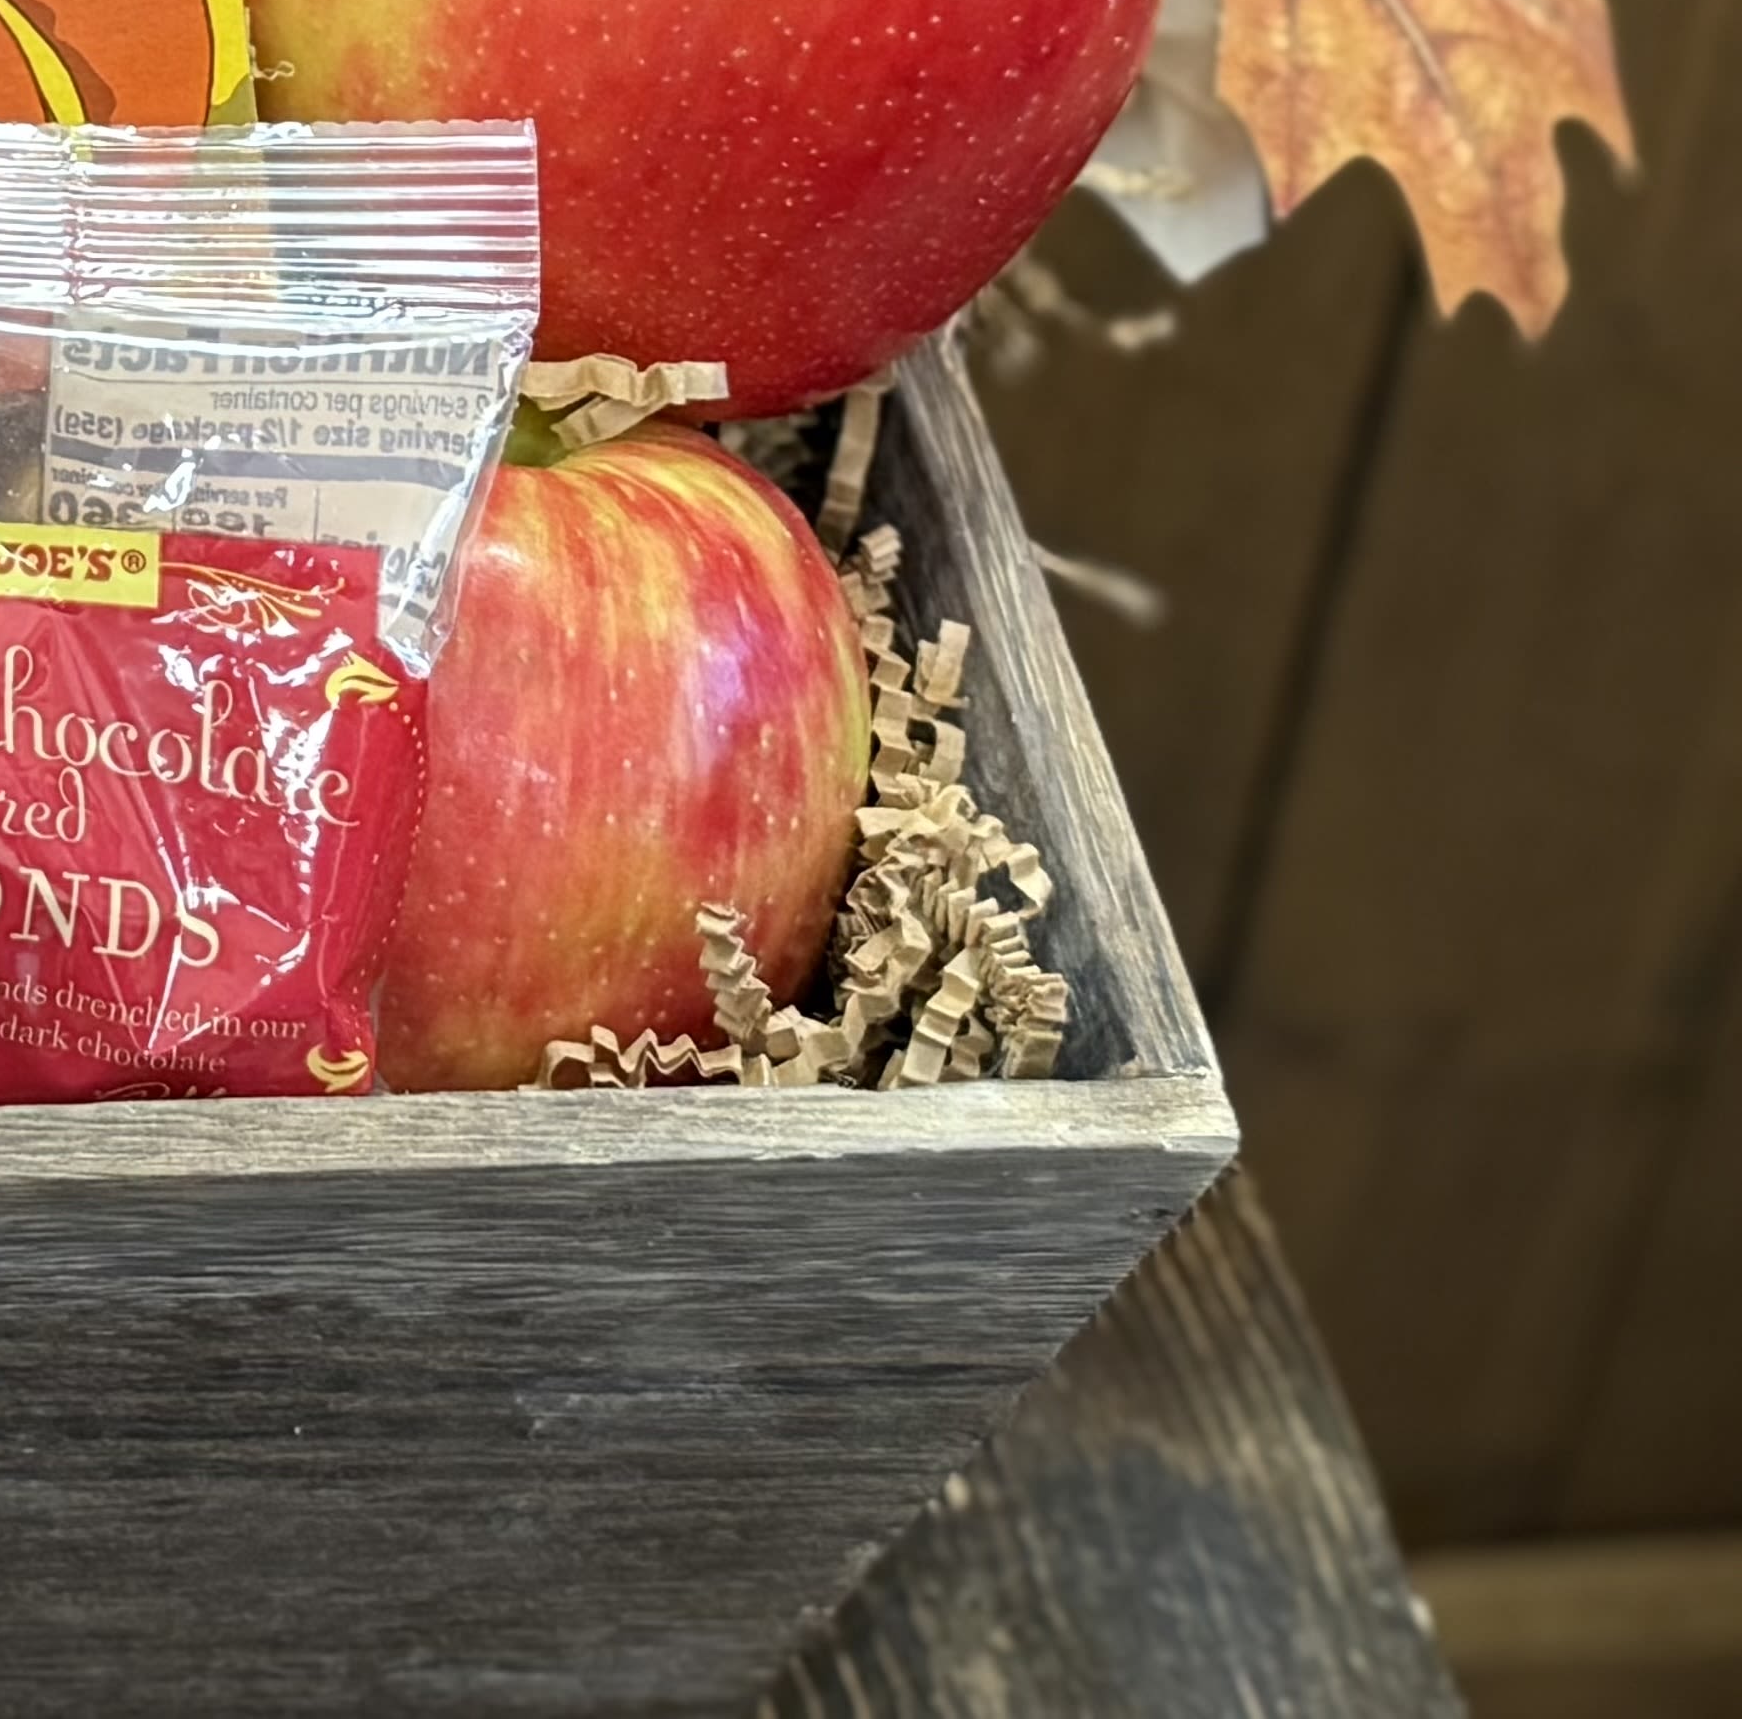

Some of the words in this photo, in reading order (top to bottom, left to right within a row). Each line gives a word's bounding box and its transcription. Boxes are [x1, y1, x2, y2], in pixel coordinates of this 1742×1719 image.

[55, 980, 203, 1032] drenched
[211, 1005, 242, 1036] in
[249, 1018, 307, 1040] our
[76, 1033, 228, 1074] chocolate
